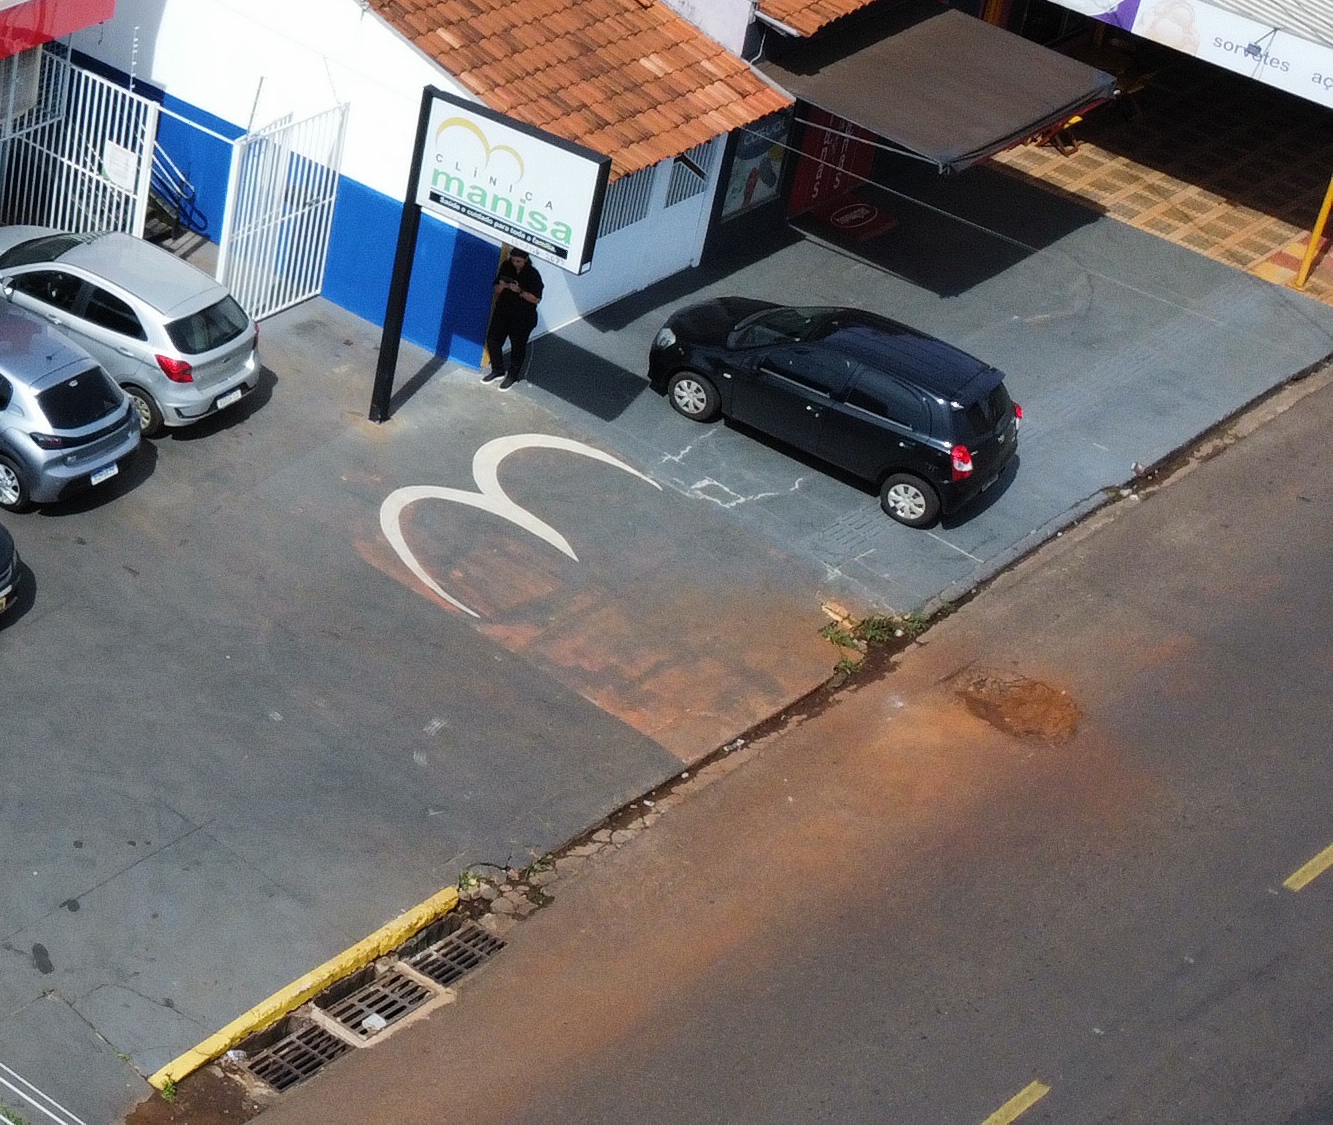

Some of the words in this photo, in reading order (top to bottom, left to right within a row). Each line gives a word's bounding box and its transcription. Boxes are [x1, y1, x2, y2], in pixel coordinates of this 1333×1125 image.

[431, 168, 572, 245] manisa
[436, 153, 553, 211] CLÍNICA
[439, 195, 461, 211] Saúde
[467, 207, 493, 225] cuidado
[494, 219, 510, 233] para
[510, 225, 526, 239] toda
